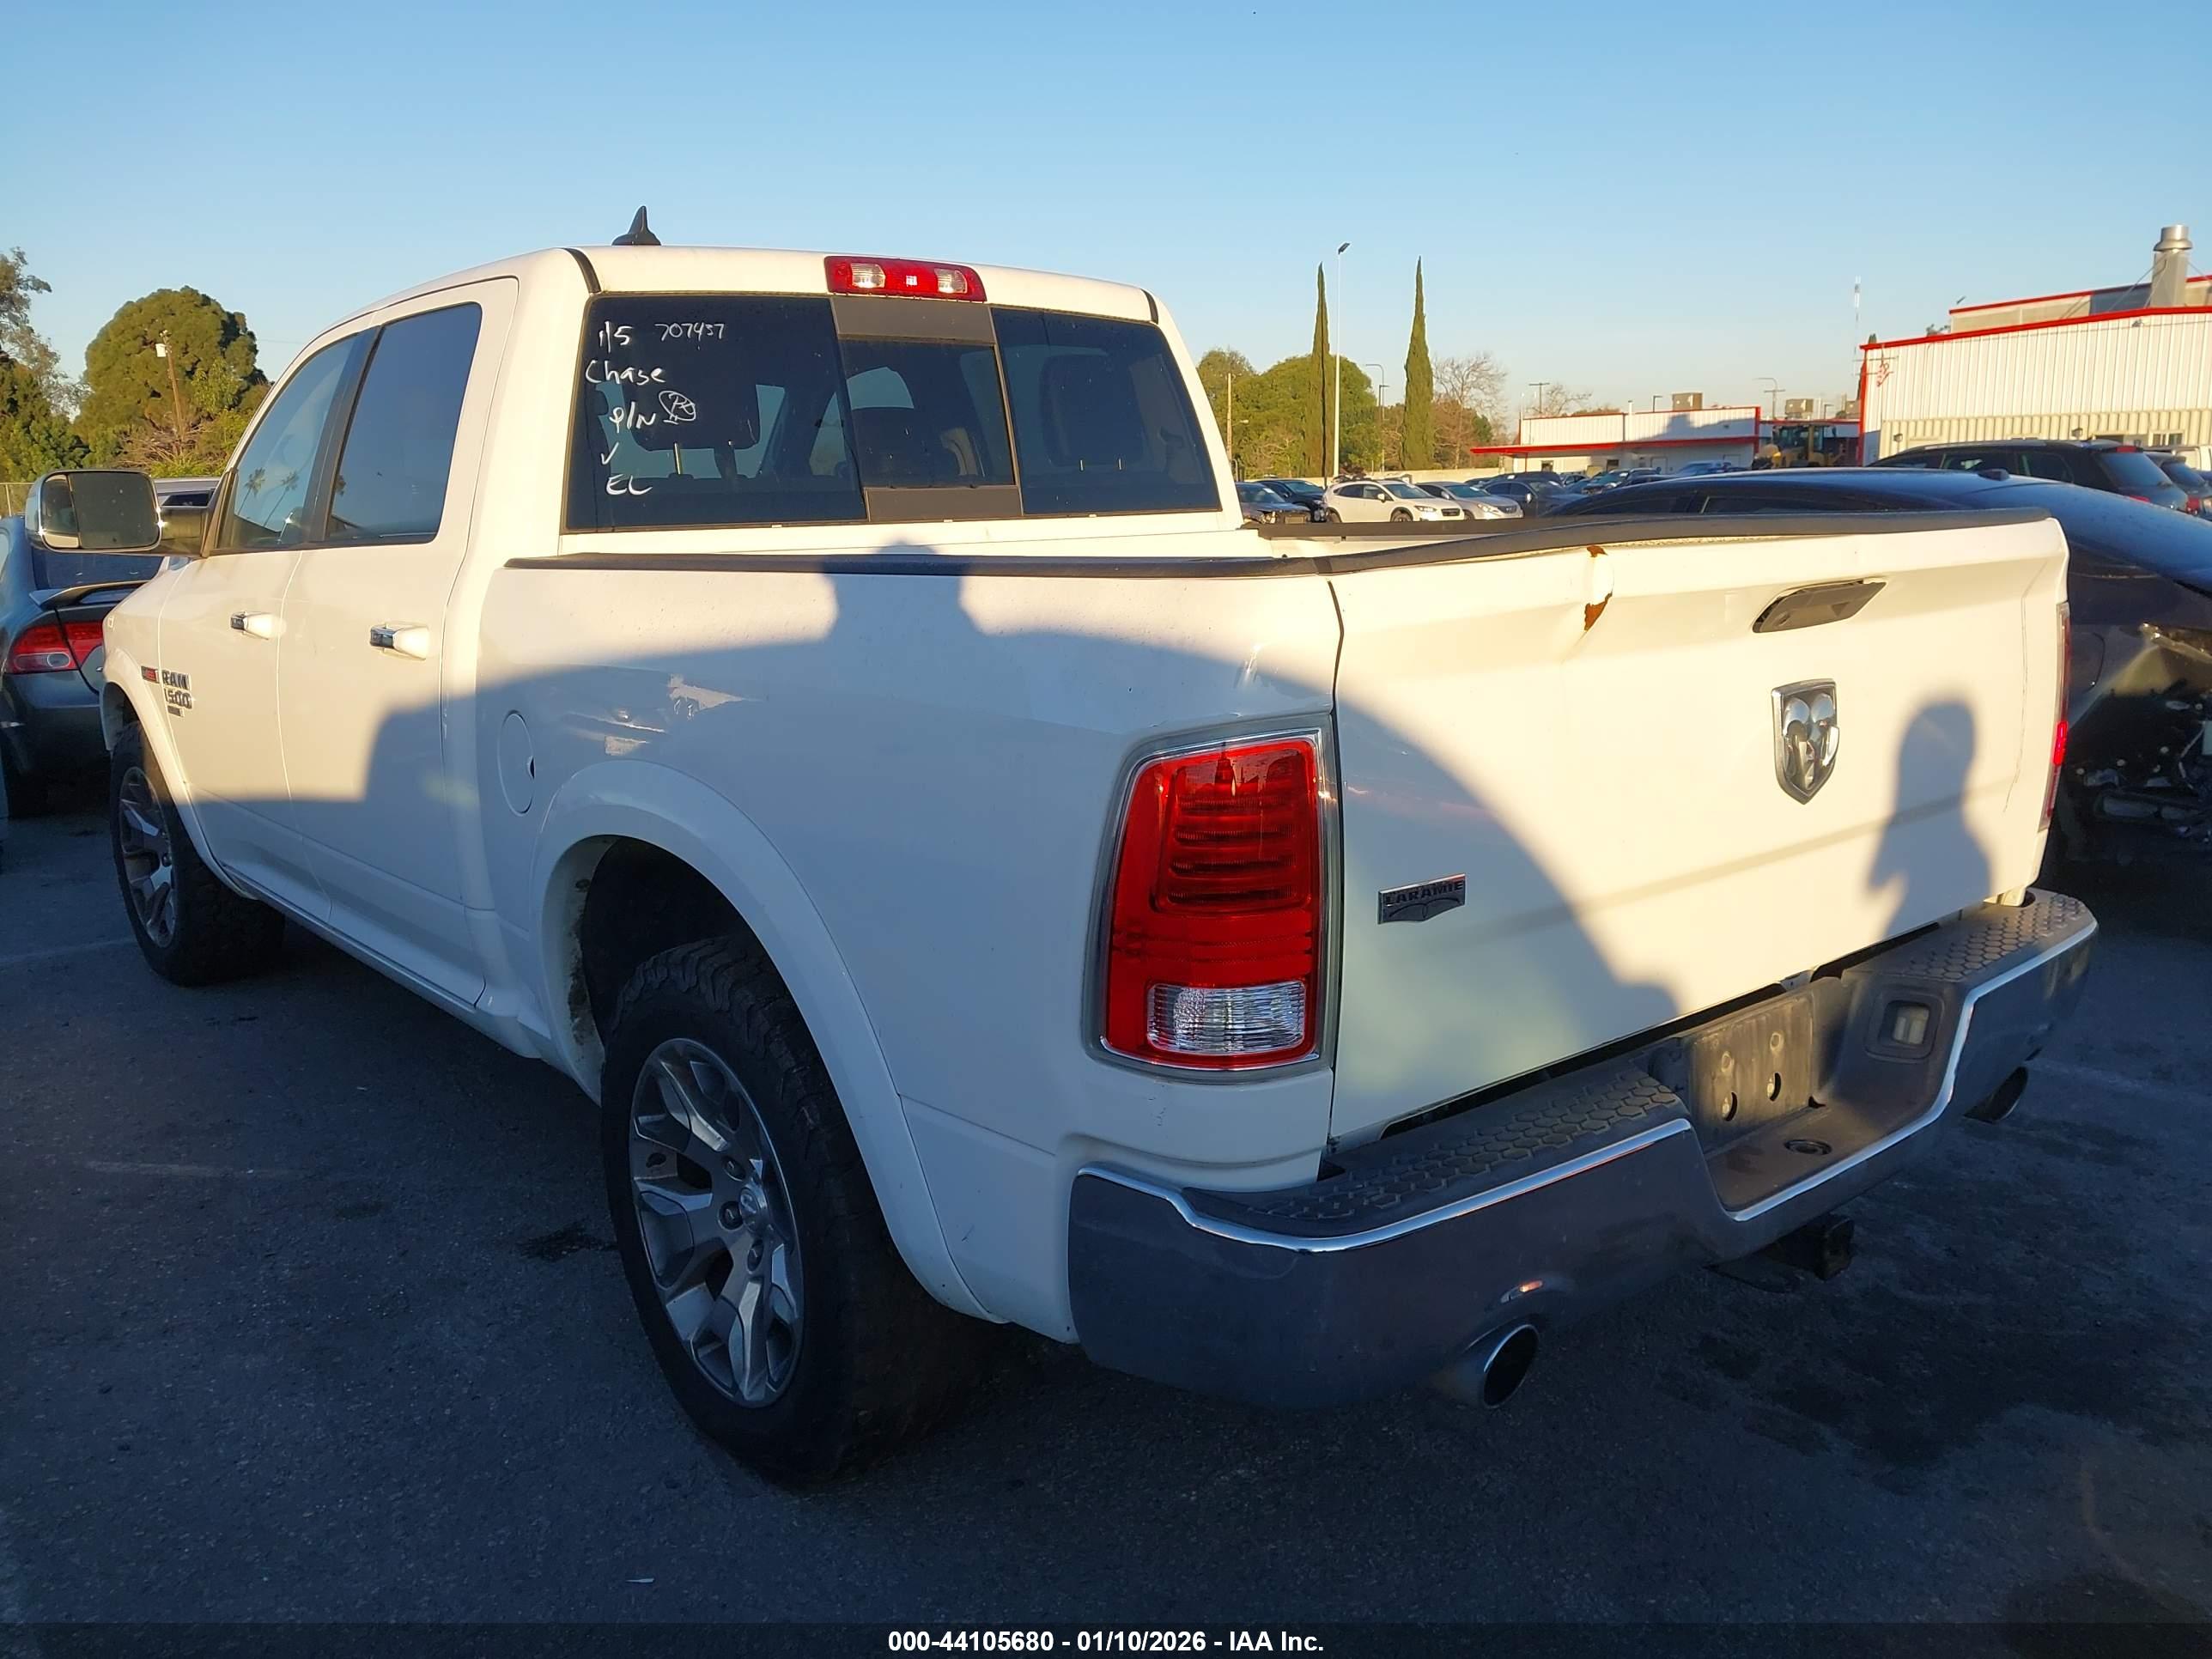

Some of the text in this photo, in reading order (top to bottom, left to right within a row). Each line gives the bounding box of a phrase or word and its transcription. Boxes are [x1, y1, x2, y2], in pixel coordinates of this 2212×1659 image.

[585, 359, 666, 386] Chase
[161, 670, 189, 690] RAM
[163, 688, 192, 709] 1500
[1383, 880, 1464, 907] LARAMIE
